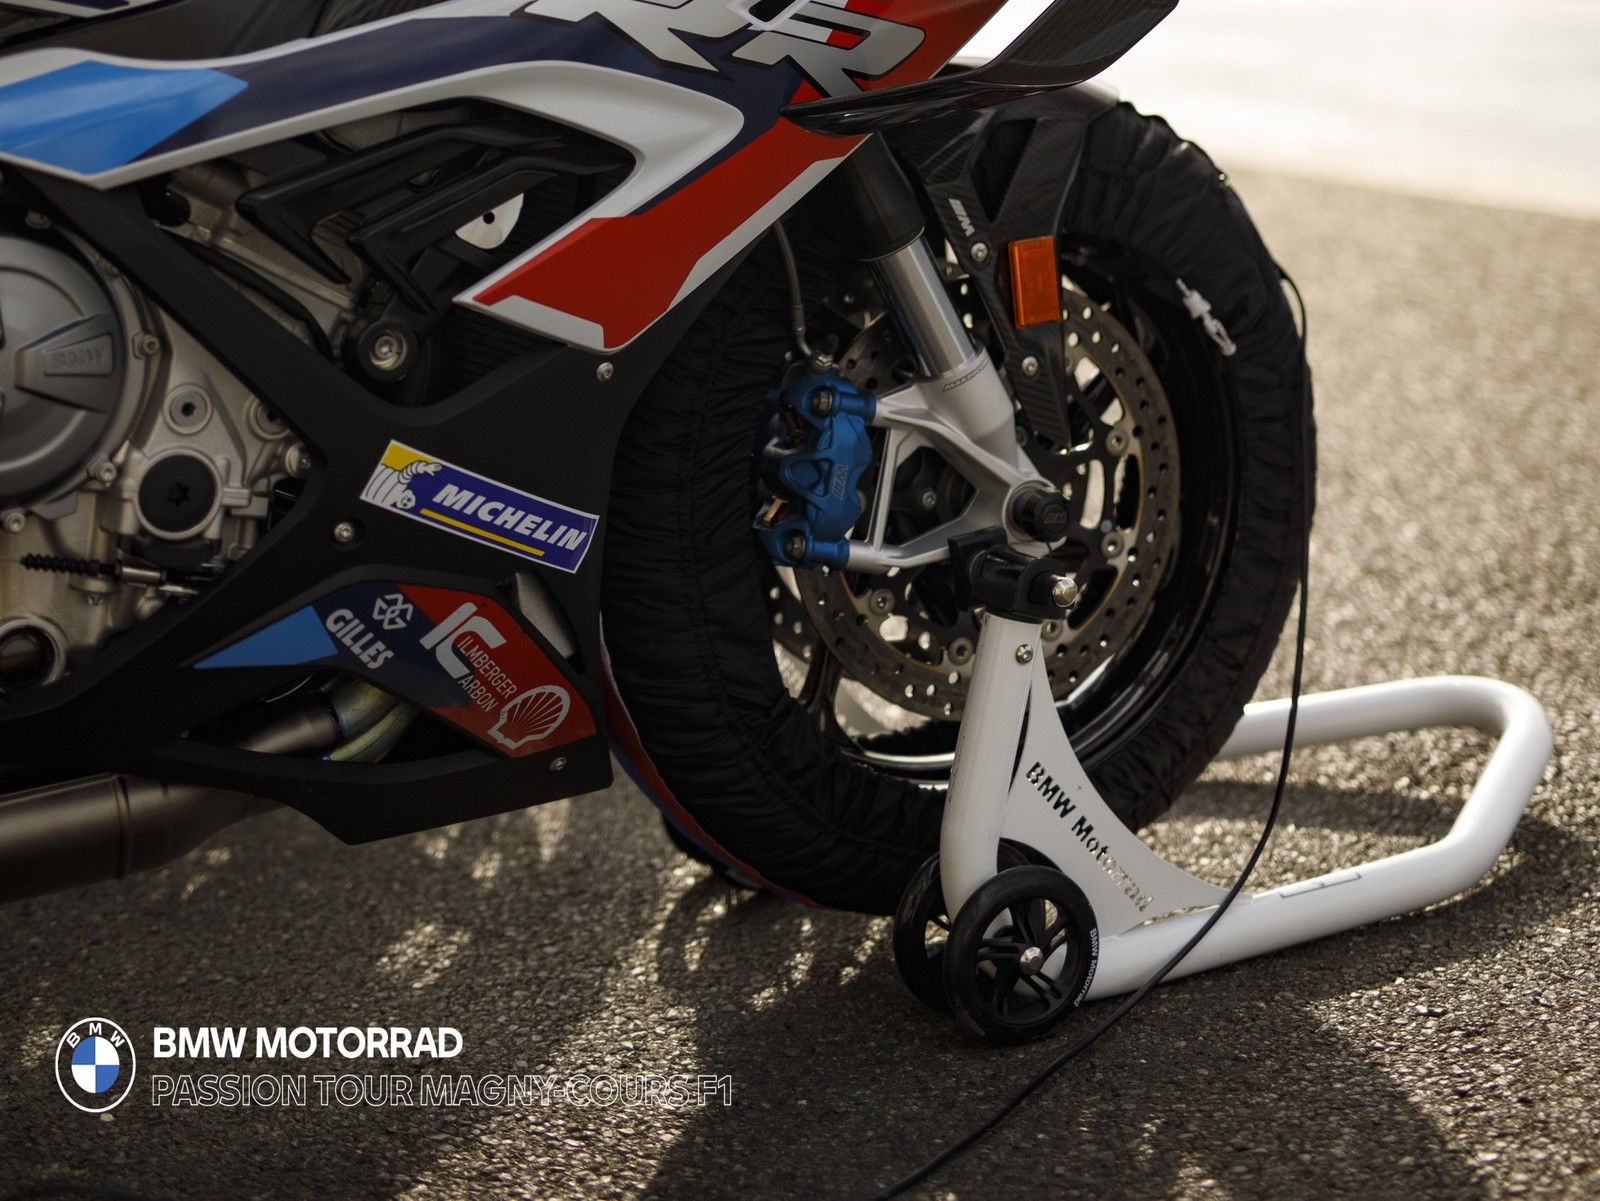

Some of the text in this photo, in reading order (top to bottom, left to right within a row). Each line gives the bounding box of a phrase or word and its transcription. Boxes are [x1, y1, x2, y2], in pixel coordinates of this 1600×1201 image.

[431, 483, 588, 551] MICHELIN
[325, 608, 395, 670] GILLES
[456, 635, 518, 700] ILMBERGER
[1025, 761, 1154, 913] BMW Motorrad
[1073, 927, 1099, 1008] BMW Motorrad
